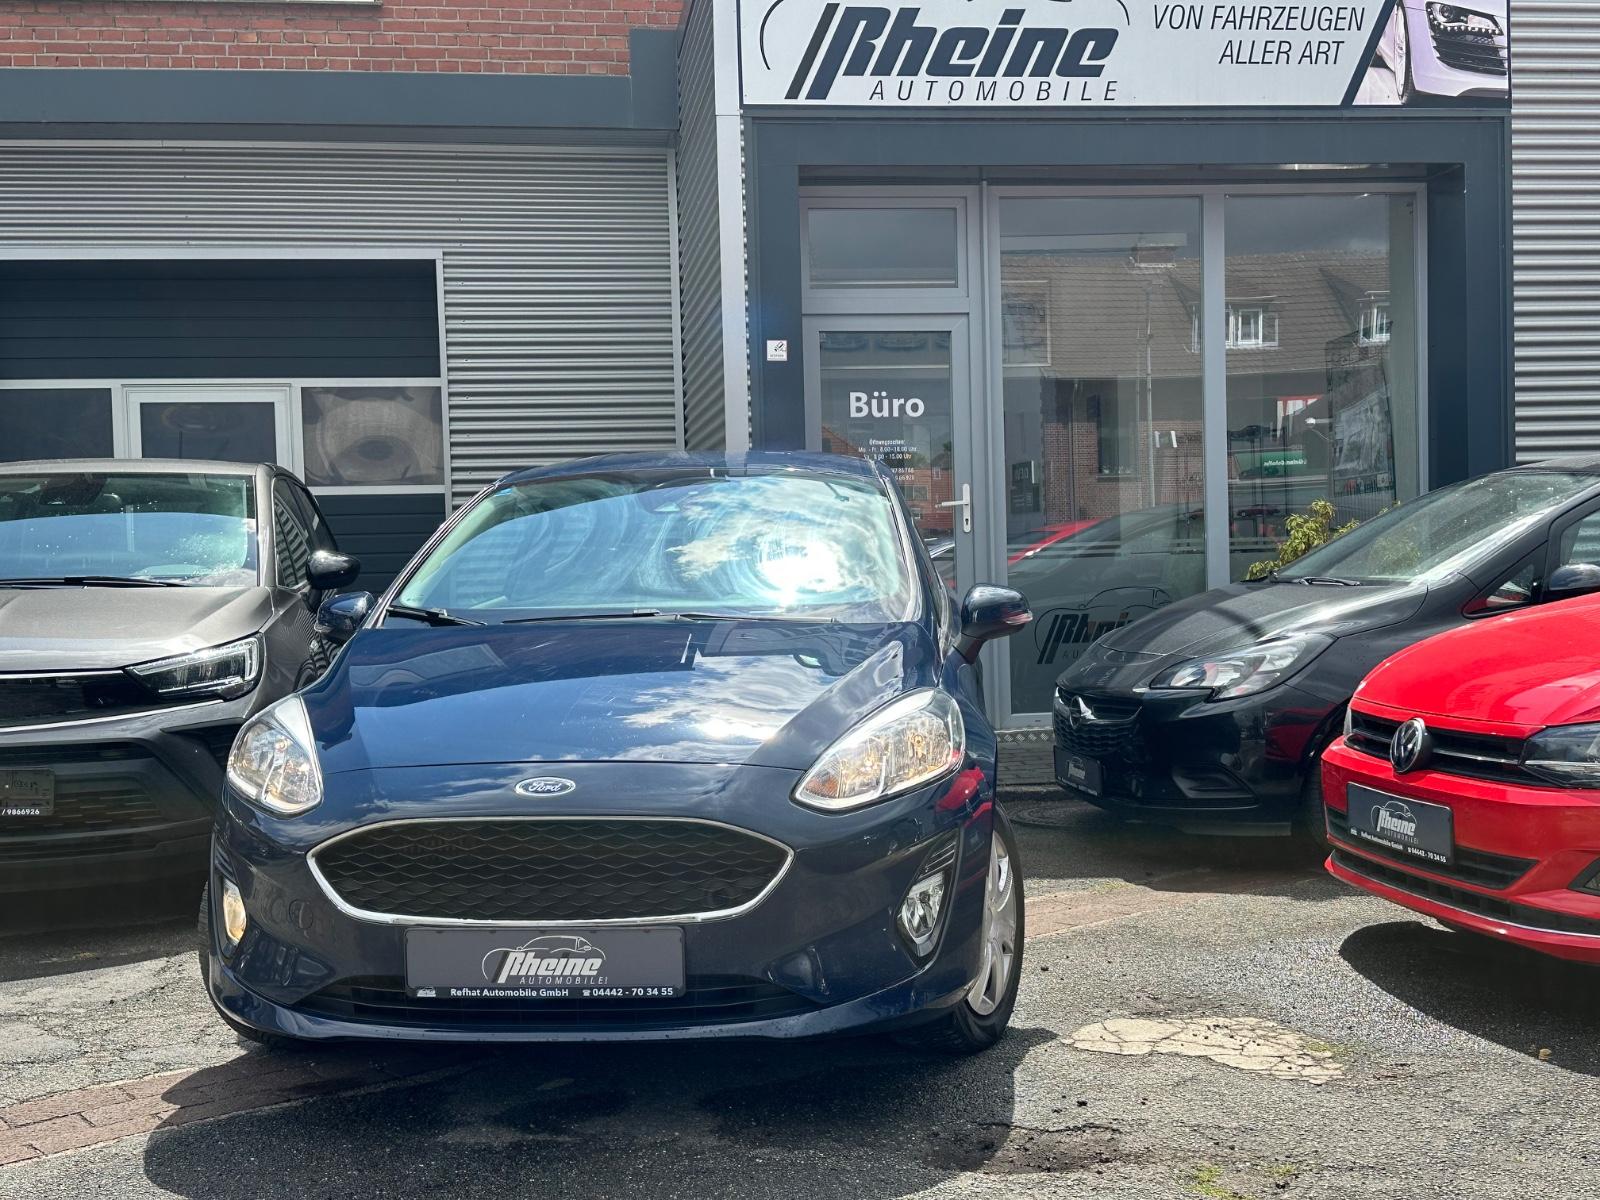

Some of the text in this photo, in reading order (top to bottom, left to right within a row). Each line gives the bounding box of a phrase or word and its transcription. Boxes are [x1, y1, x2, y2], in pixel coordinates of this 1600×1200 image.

[1153, 4, 1366, 32] VON FAHRZEUGEN
[798, 6, 1120, 100] Rheine
[1218, 39, 1345, 65] ALLER ART
[868, 79, 1119, 102] AUTOMOBILE
[849, 390, 925, 418] Büro
[528, 780, 562, 792] Ford
[496, 951, 604, 984] Rheine
[450, 987, 481, 997] Refhat
[482, 987, 537, 997] Automobile
[539, 987, 569, 997] GmbH
[592, 987, 623, 997] 04442
[631, 987, 644, 997] 70
[646, 987, 659, 997] 34
[661, 986, 674, 996] 55
